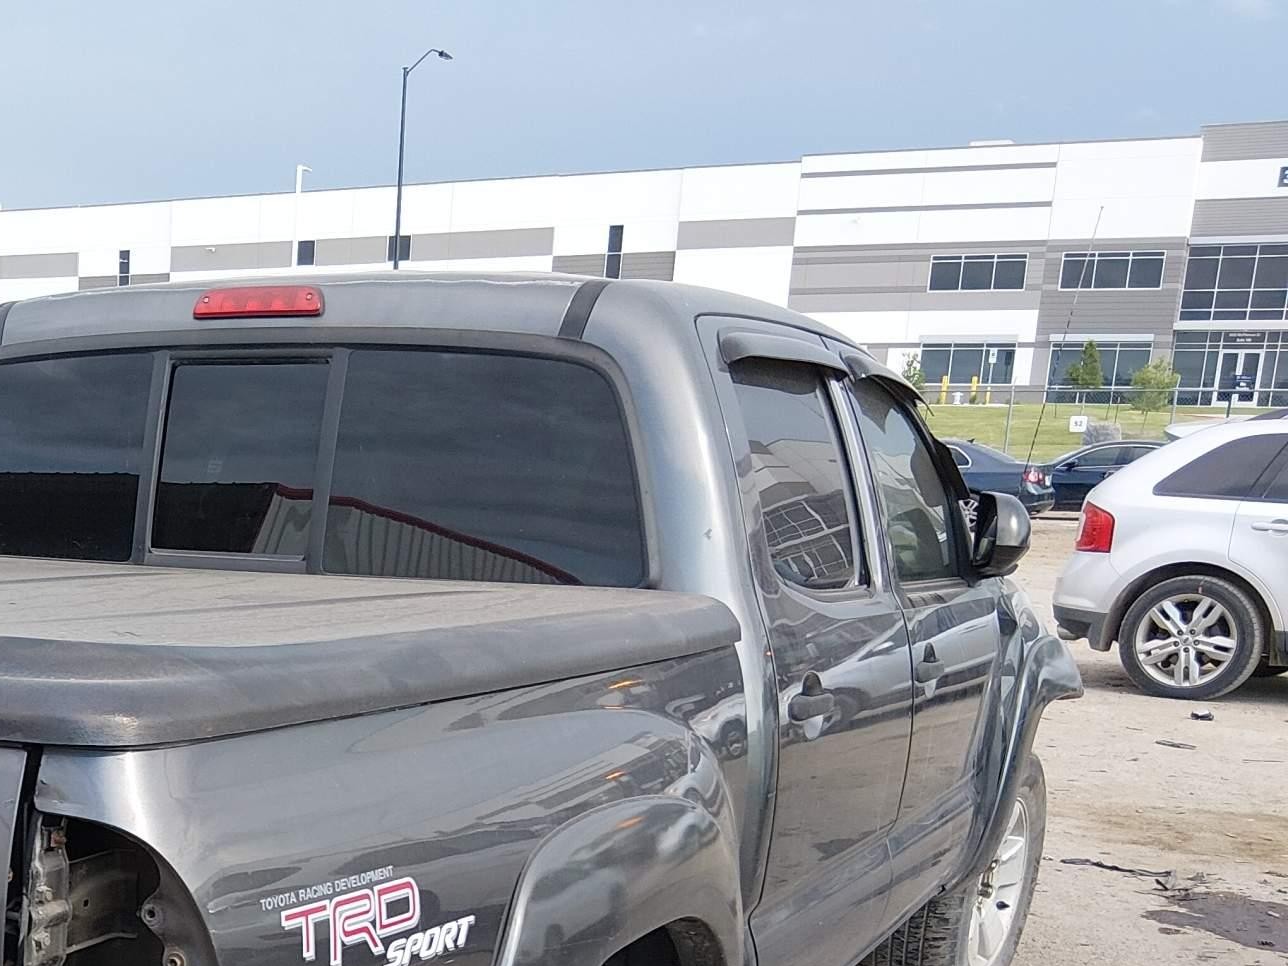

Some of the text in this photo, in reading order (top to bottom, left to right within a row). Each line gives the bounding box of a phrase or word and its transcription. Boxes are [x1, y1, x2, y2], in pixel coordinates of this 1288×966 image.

[260, 865, 395, 912] TOYOTA RACING DEVELOPMENT
